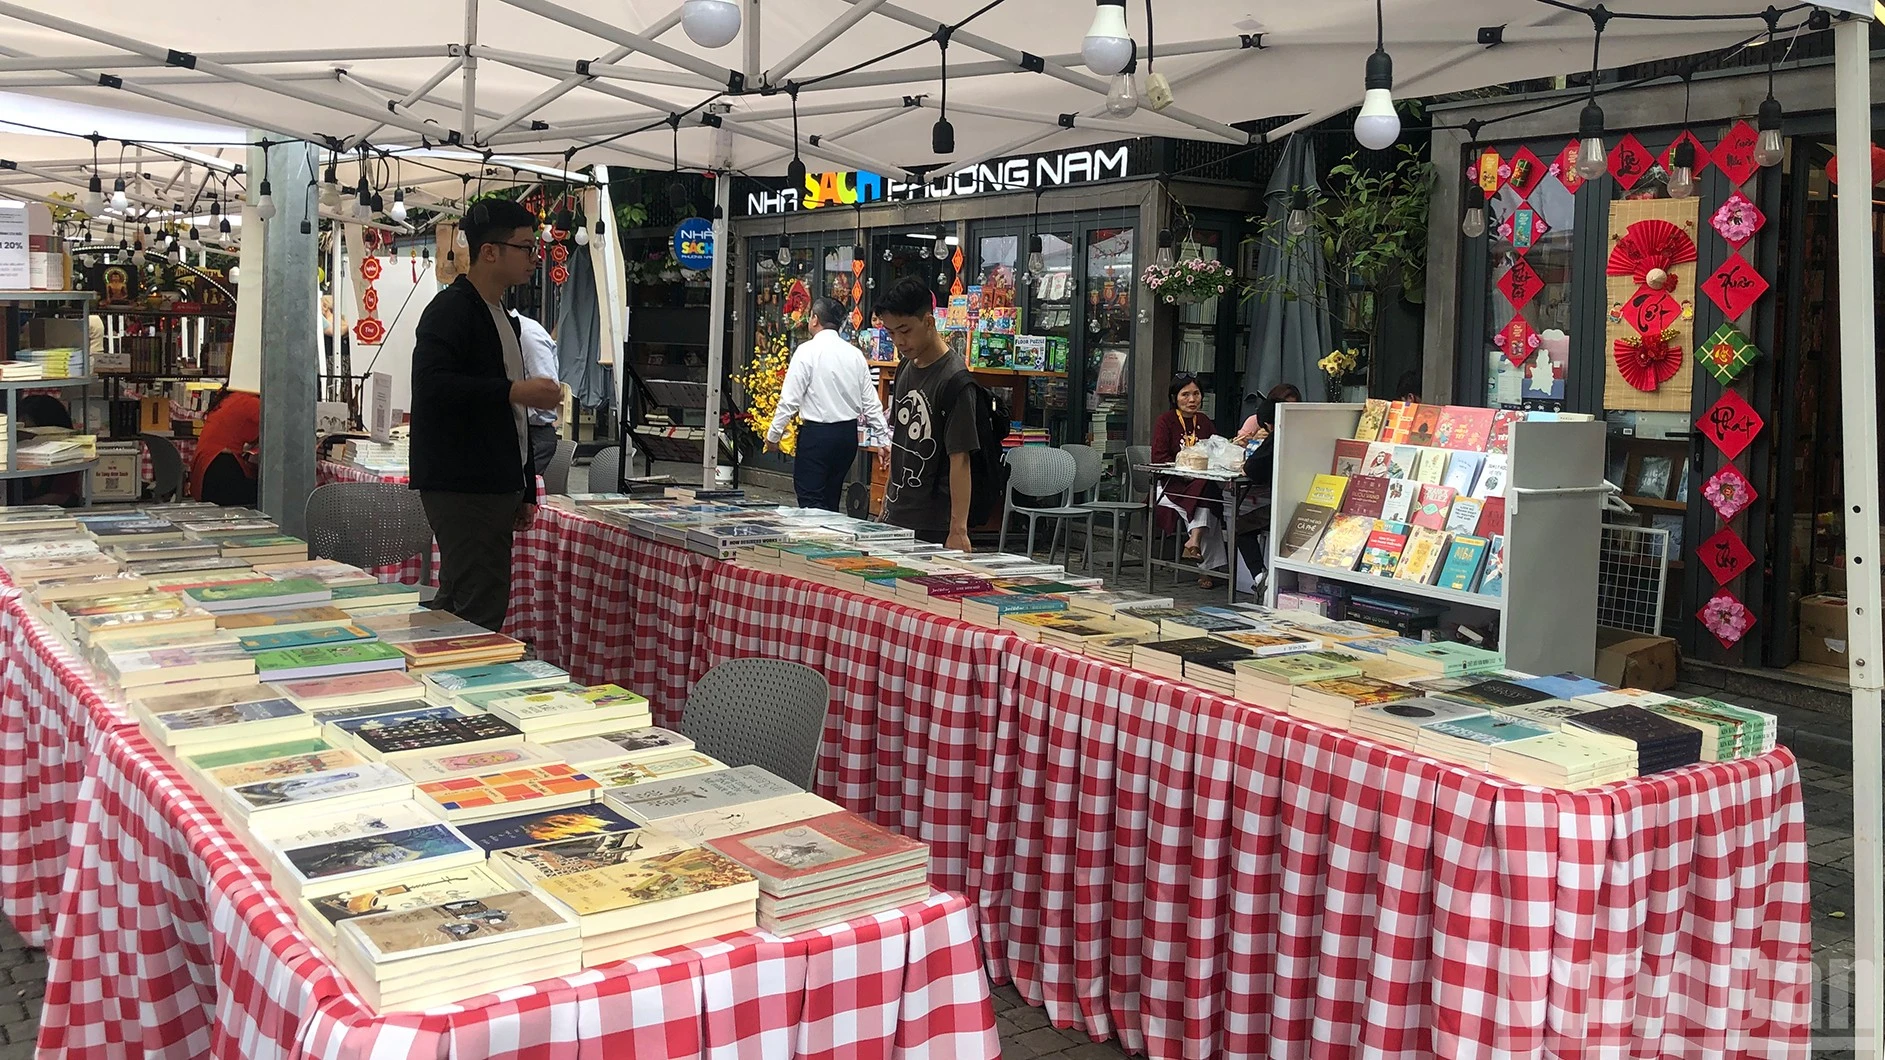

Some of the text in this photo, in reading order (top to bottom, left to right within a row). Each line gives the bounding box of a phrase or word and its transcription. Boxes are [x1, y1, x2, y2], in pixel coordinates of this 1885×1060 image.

[1036, 146, 1129, 187] NAM
[4, 241, 23, 250] 20%
[1717, 266, 1755, 309] Xuân
[1633, 293, 1671, 332] Tết
[1710, 406, 1755, 441] Phát
